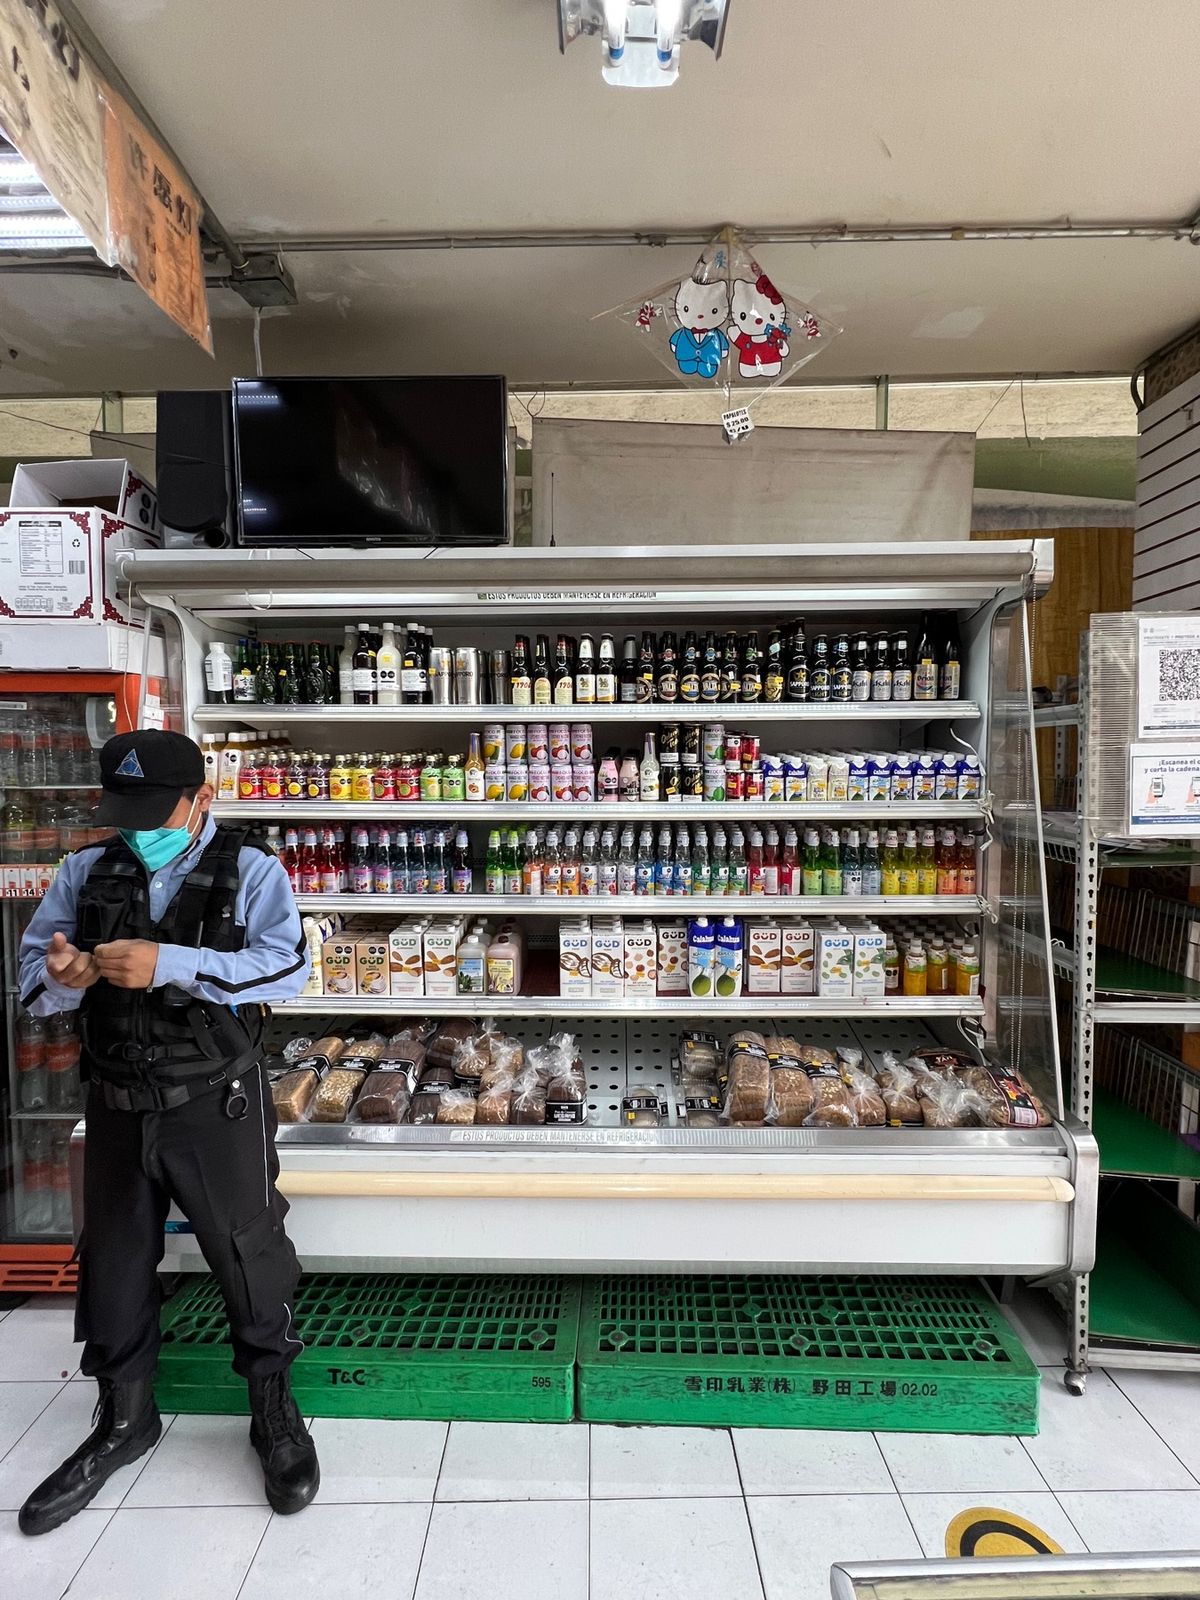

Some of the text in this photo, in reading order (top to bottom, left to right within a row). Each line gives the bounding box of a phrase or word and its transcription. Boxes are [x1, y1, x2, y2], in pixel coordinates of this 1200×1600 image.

[462, 1130, 484, 1141] ESTOS
[485, 1130, 525, 1141] PRODUCTOS
[526, 1130, 548, 1141] DEBEN
[549, 1130, 595, 1142] MANTENERSE
[596, 1131, 605, 1142] EN
[531, 1376, 552, 1388] 595
[684, 1376, 938, 1397] 雪印乳業(株) 野田工場 02.02
